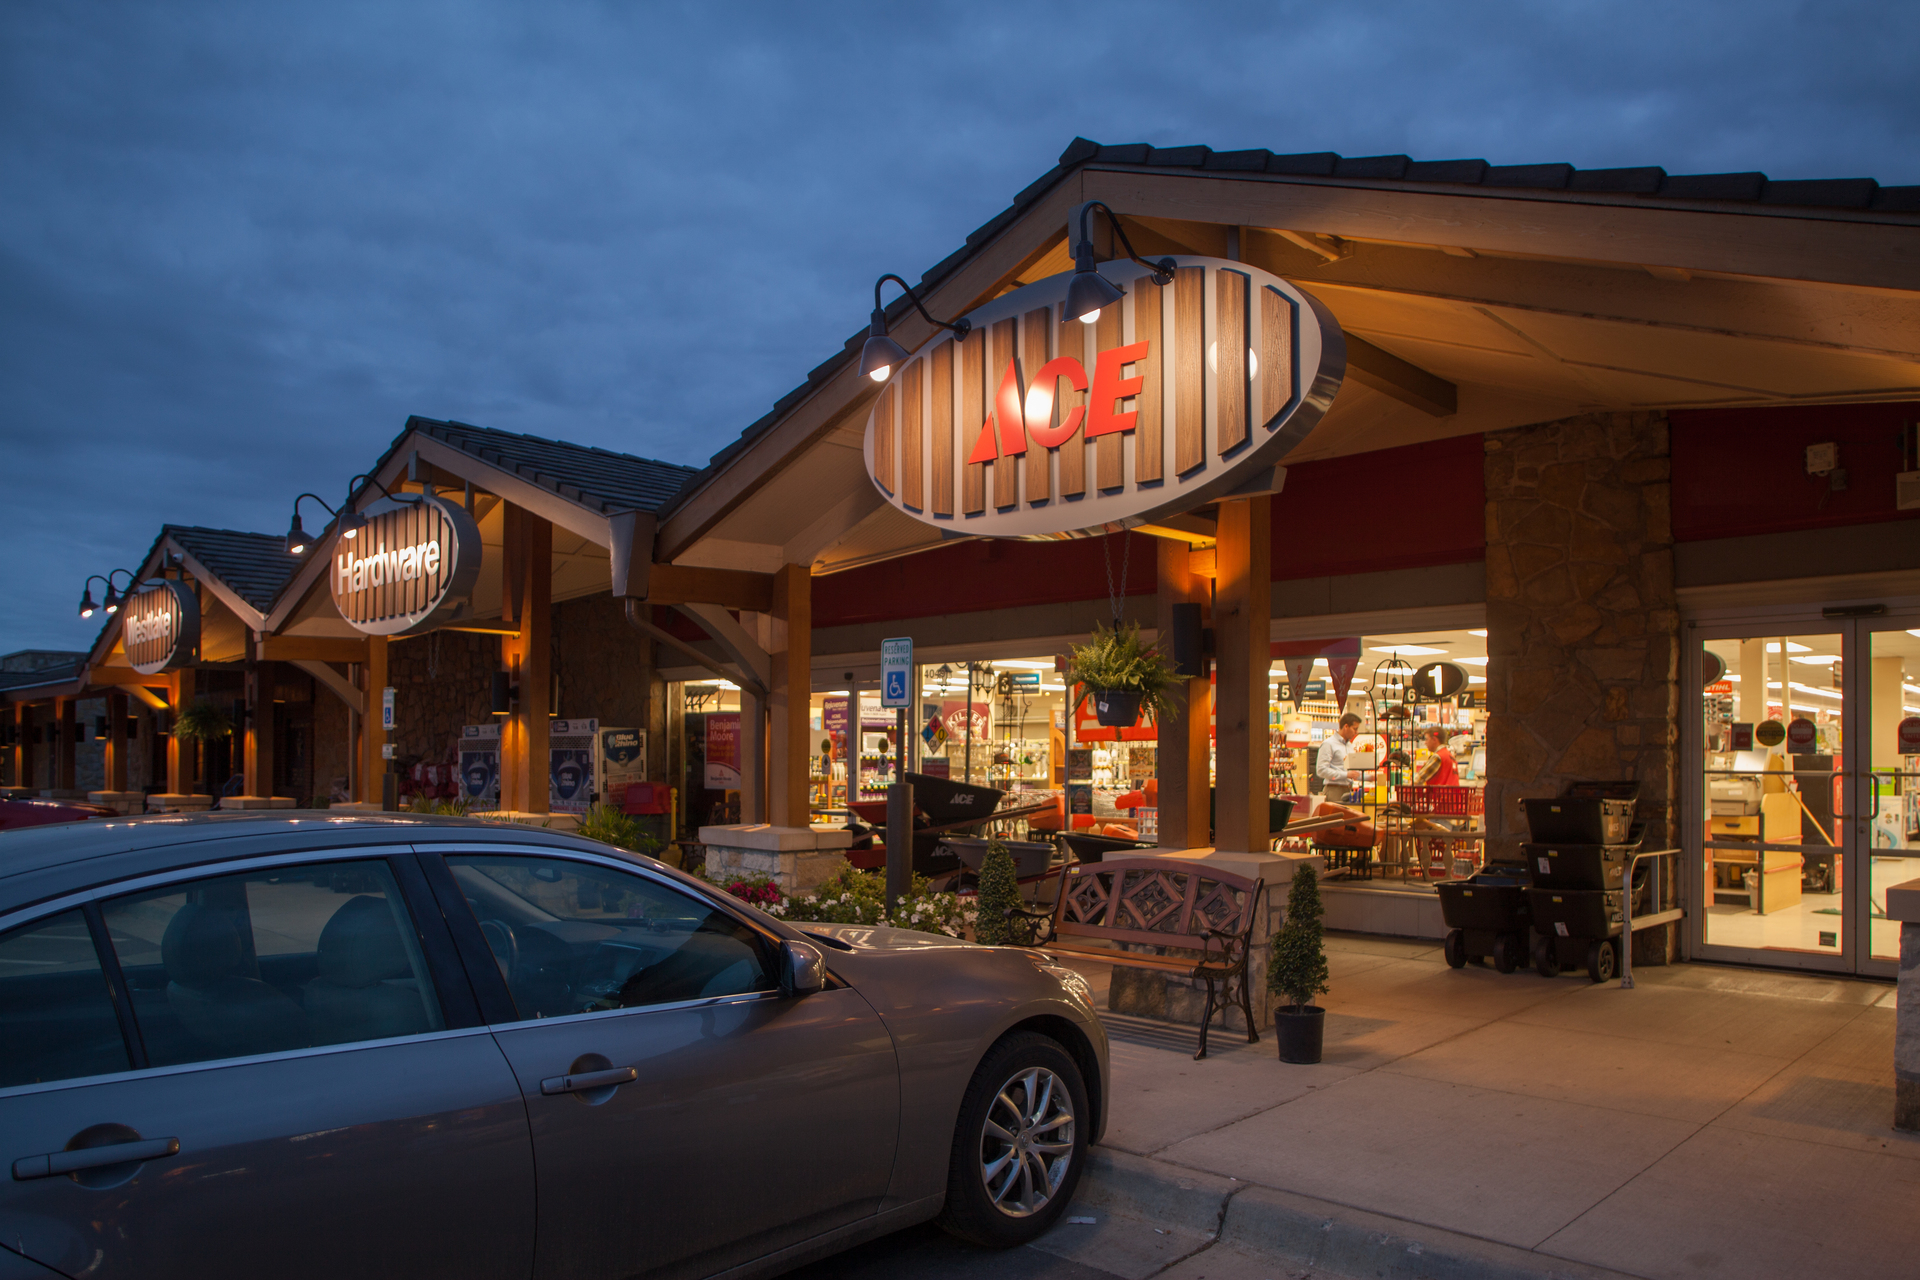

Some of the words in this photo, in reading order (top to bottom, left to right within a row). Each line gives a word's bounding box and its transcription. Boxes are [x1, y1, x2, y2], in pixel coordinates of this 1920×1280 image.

[968, 340, 1150, 465] ACE
[337, 540, 440, 596] Hardware
[126, 608, 171, 647] Westlake
[884, 644, 909, 655] RESERVED
[884, 656, 909, 666] PARKING
[924, 668, 946, 679] 4049
[1427, 664, 1443, 695] 1
[1295, 664, 1303, 697] STIHL
[1339, 664, 1347, 697] STIHL
[1281, 685, 1290, 699] 5
[1407, 688, 1417, 702] 6
[1461, 693, 1471, 706] 7
[931, 719, 938, 730] 4
[946, 711, 986, 729] KILER
[616, 733, 634, 741] Blue
[710, 731, 734, 741] Moore
[925, 728, 930, 739] 1
[938, 729, 945, 740] 0
[1353, 741, 1385, 753] SAGS
[950, 793, 975, 805] ACE
